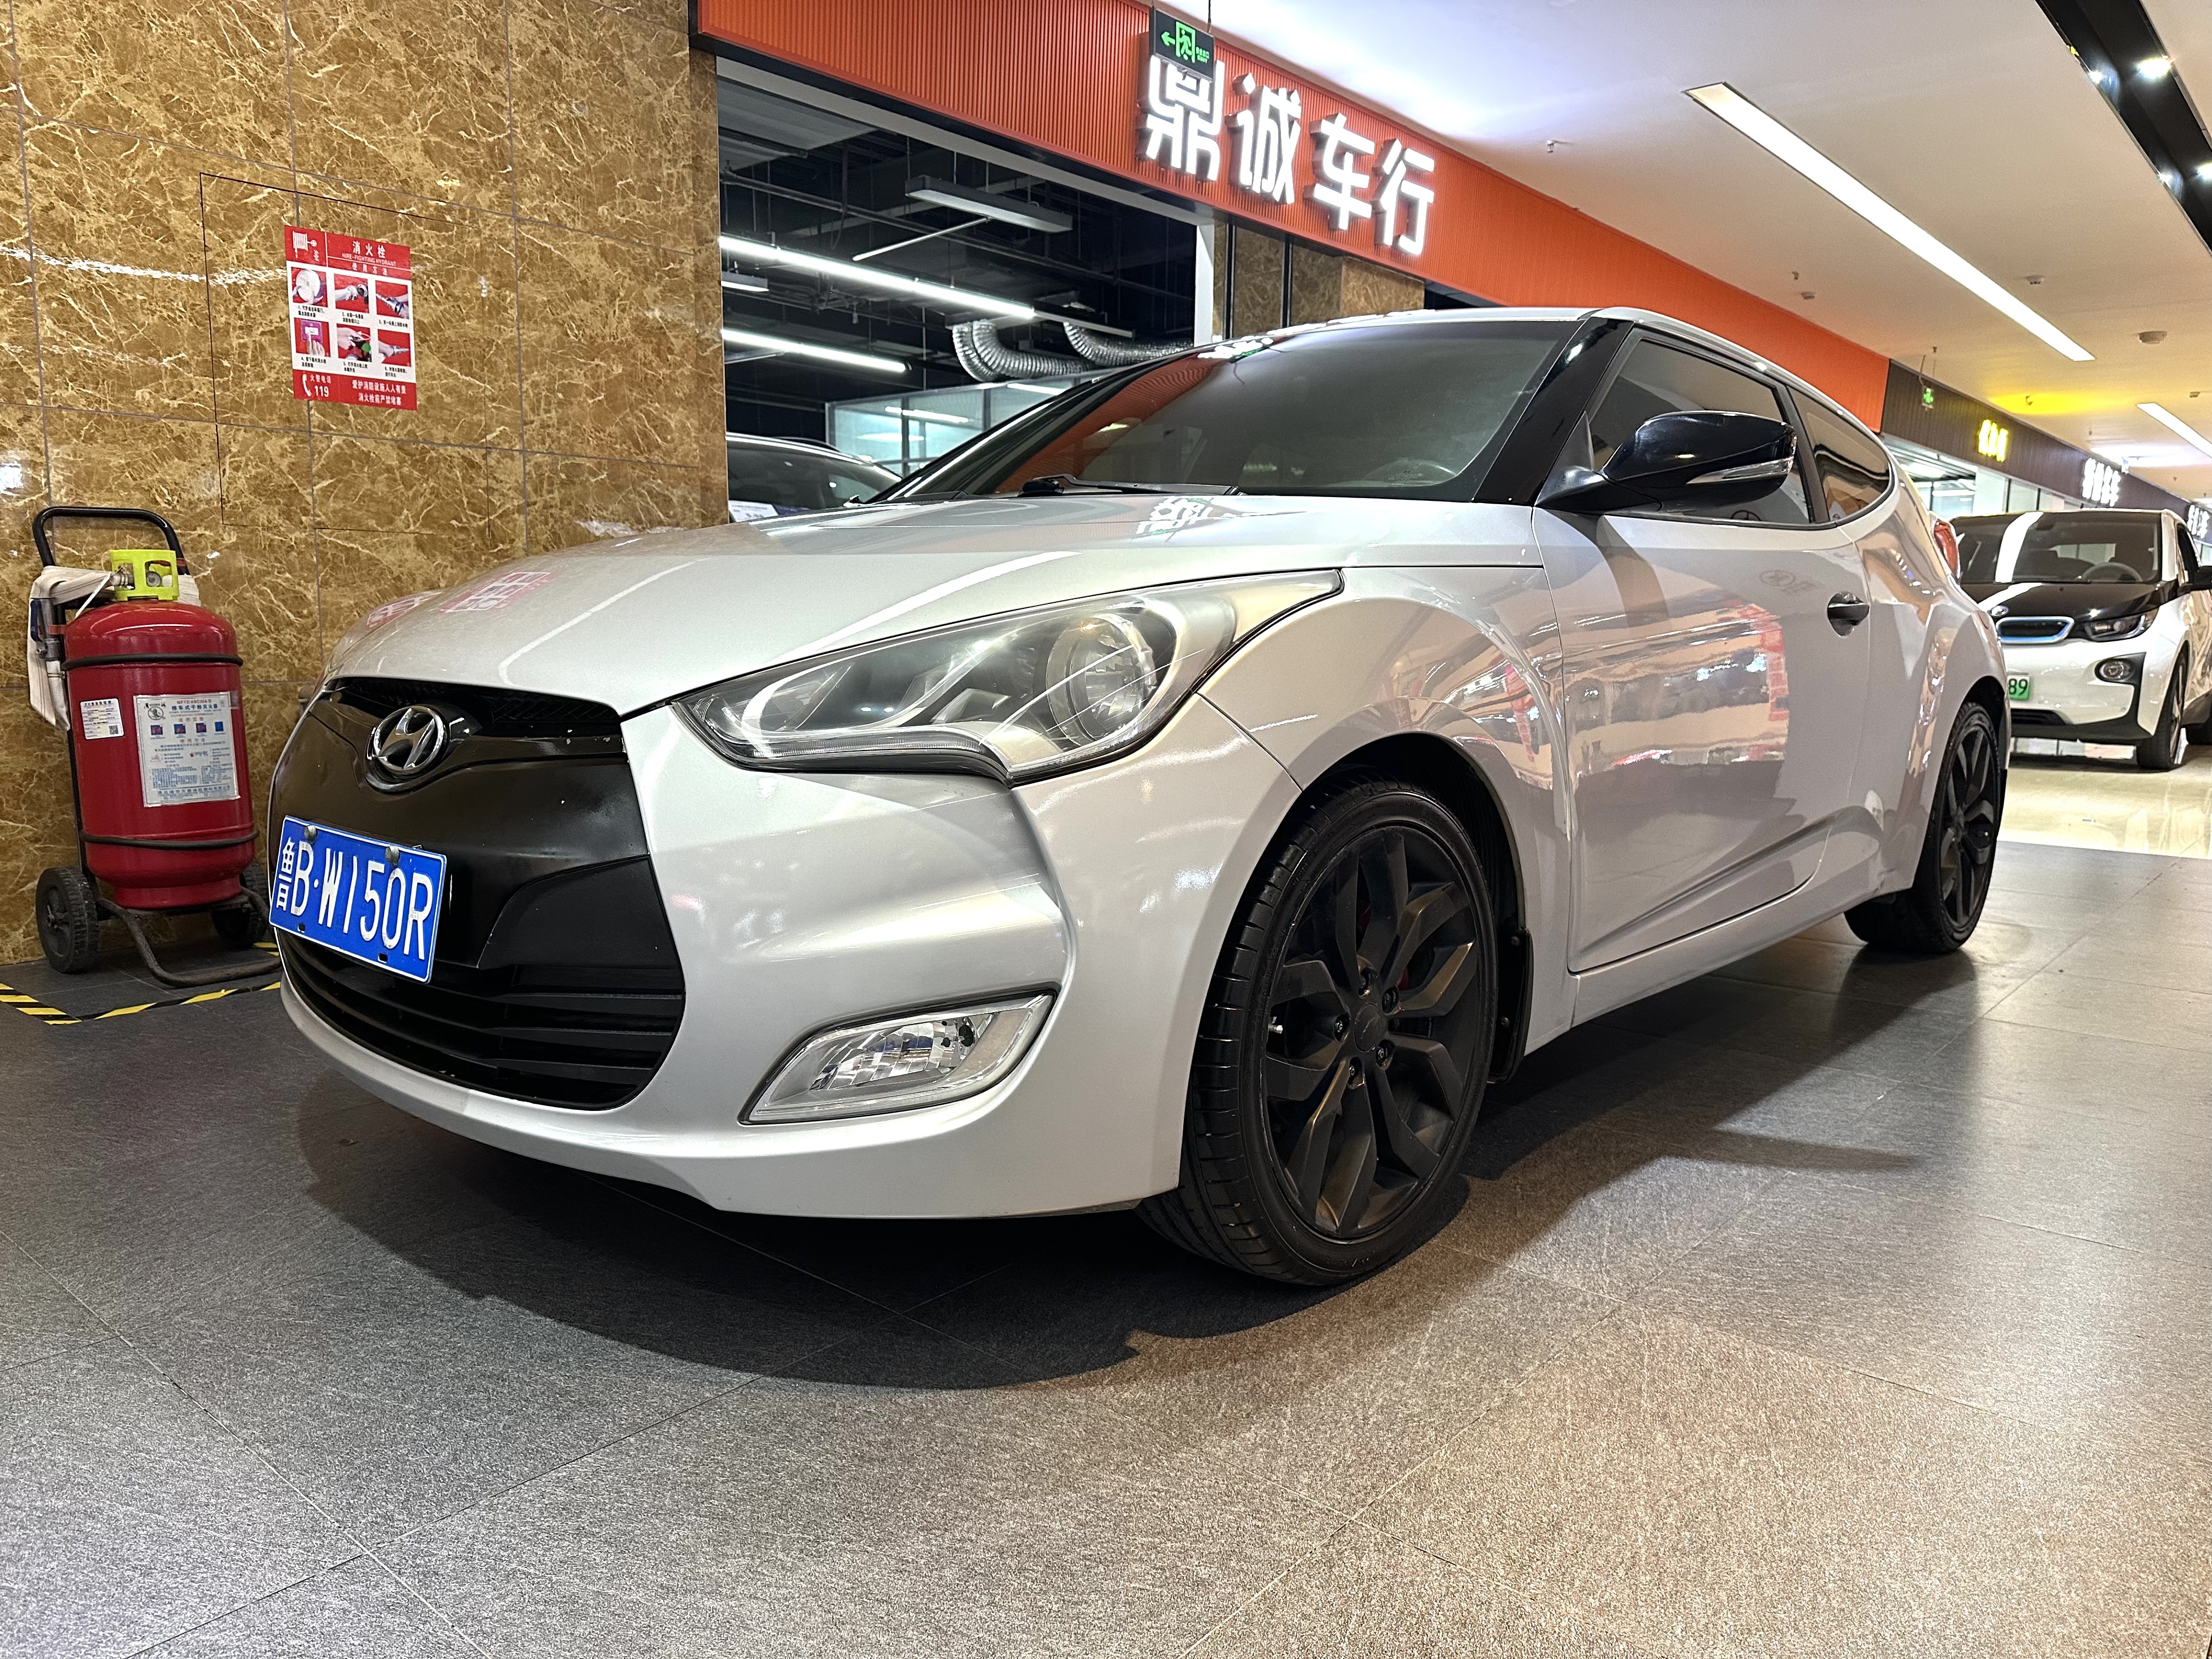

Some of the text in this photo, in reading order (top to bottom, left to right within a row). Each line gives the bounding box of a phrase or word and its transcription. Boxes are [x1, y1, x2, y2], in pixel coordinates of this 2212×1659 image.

[1145, 54, 1436, 256] 鼎诚车行
[352, 240, 386, 259] 消火栓
[352, 262, 388, 276] 使用方法
[314, 385, 329, 398] 119
[2008, 678, 2028, 696] 89
[276, 837, 433, 960] 鲁B·W150R
